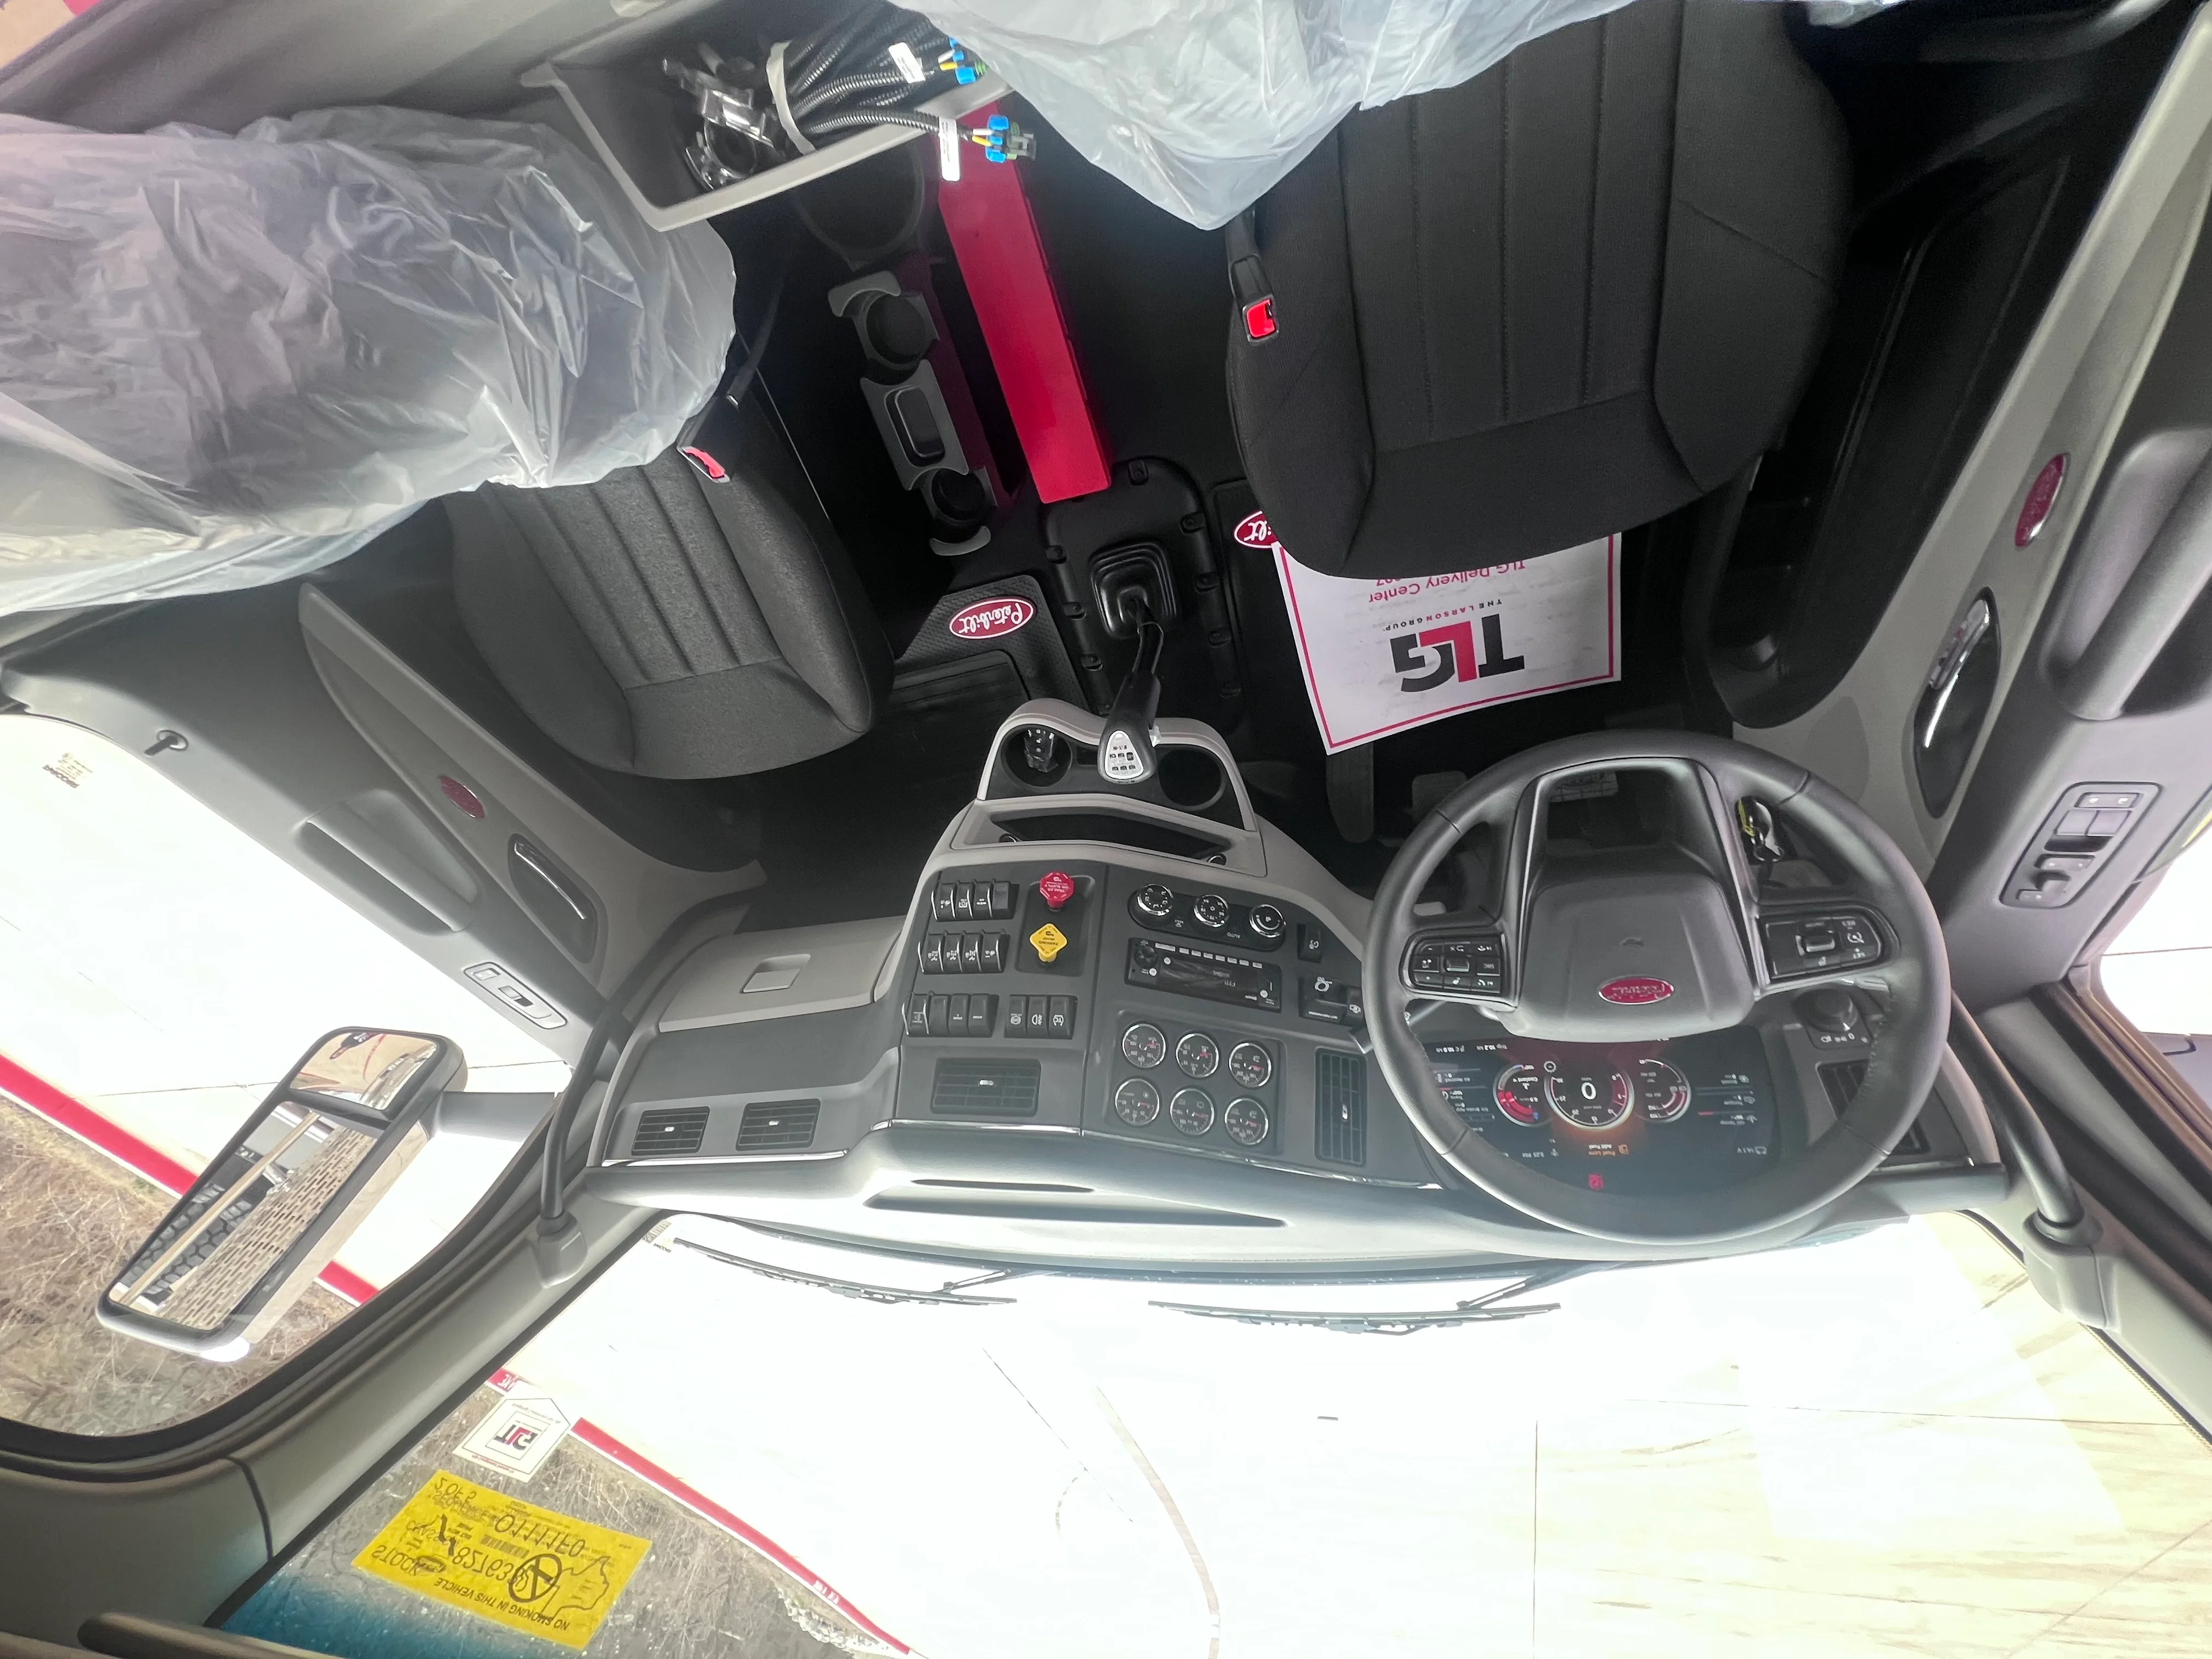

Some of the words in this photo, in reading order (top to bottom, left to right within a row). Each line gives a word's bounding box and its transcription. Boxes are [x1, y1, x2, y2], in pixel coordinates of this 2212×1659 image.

[1496, 560, 1525, 574] TLG
[1426, 567, 1489, 589] Delivery
[1369, 583, 1420, 602] Center
[1426, 605, 1474, 621] LARSON
[1479, 599, 1502, 609] THE
[958, 603, 1023, 633] Peterbilt
[1390, 614, 1525, 692] TLG
[1581, 1082, 1596, 1100] 0
[433, 1577, 476, 1600] VEHICLE
[475, 1592, 498, 1609] THIS
[498, 1599, 510, 1612] IN
[508, 1603, 553, 1627] SMOKING
[555, 1618, 571, 1632] NO
